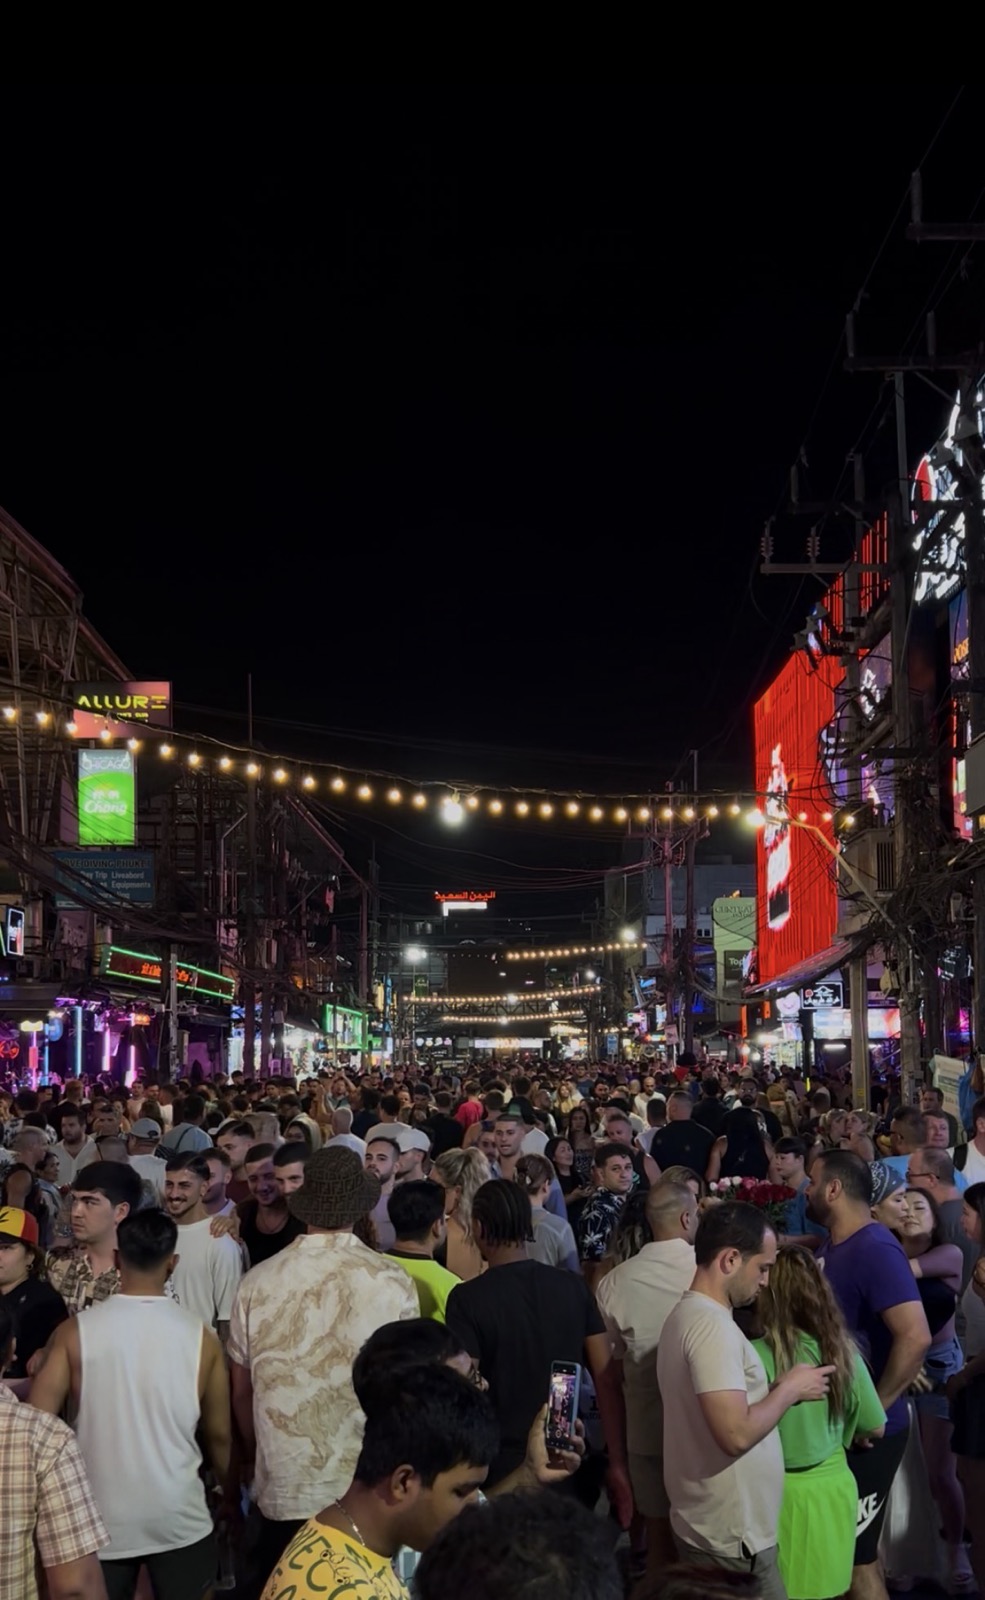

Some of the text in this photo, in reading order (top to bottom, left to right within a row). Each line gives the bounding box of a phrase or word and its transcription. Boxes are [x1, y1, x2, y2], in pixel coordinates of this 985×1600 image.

[78, 695, 167, 709] ALLURE
[82, 757, 131, 770] CHICAGO
[84, 800, 128, 817] Chang
[83, 859, 115, 868] DIVING
[95, 871, 108, 879] Trip
[111, 881, 151, 890] Equipments
[715, 905, 754, 913] CENTRAL
[857, 1492, 878, 1522] KE
